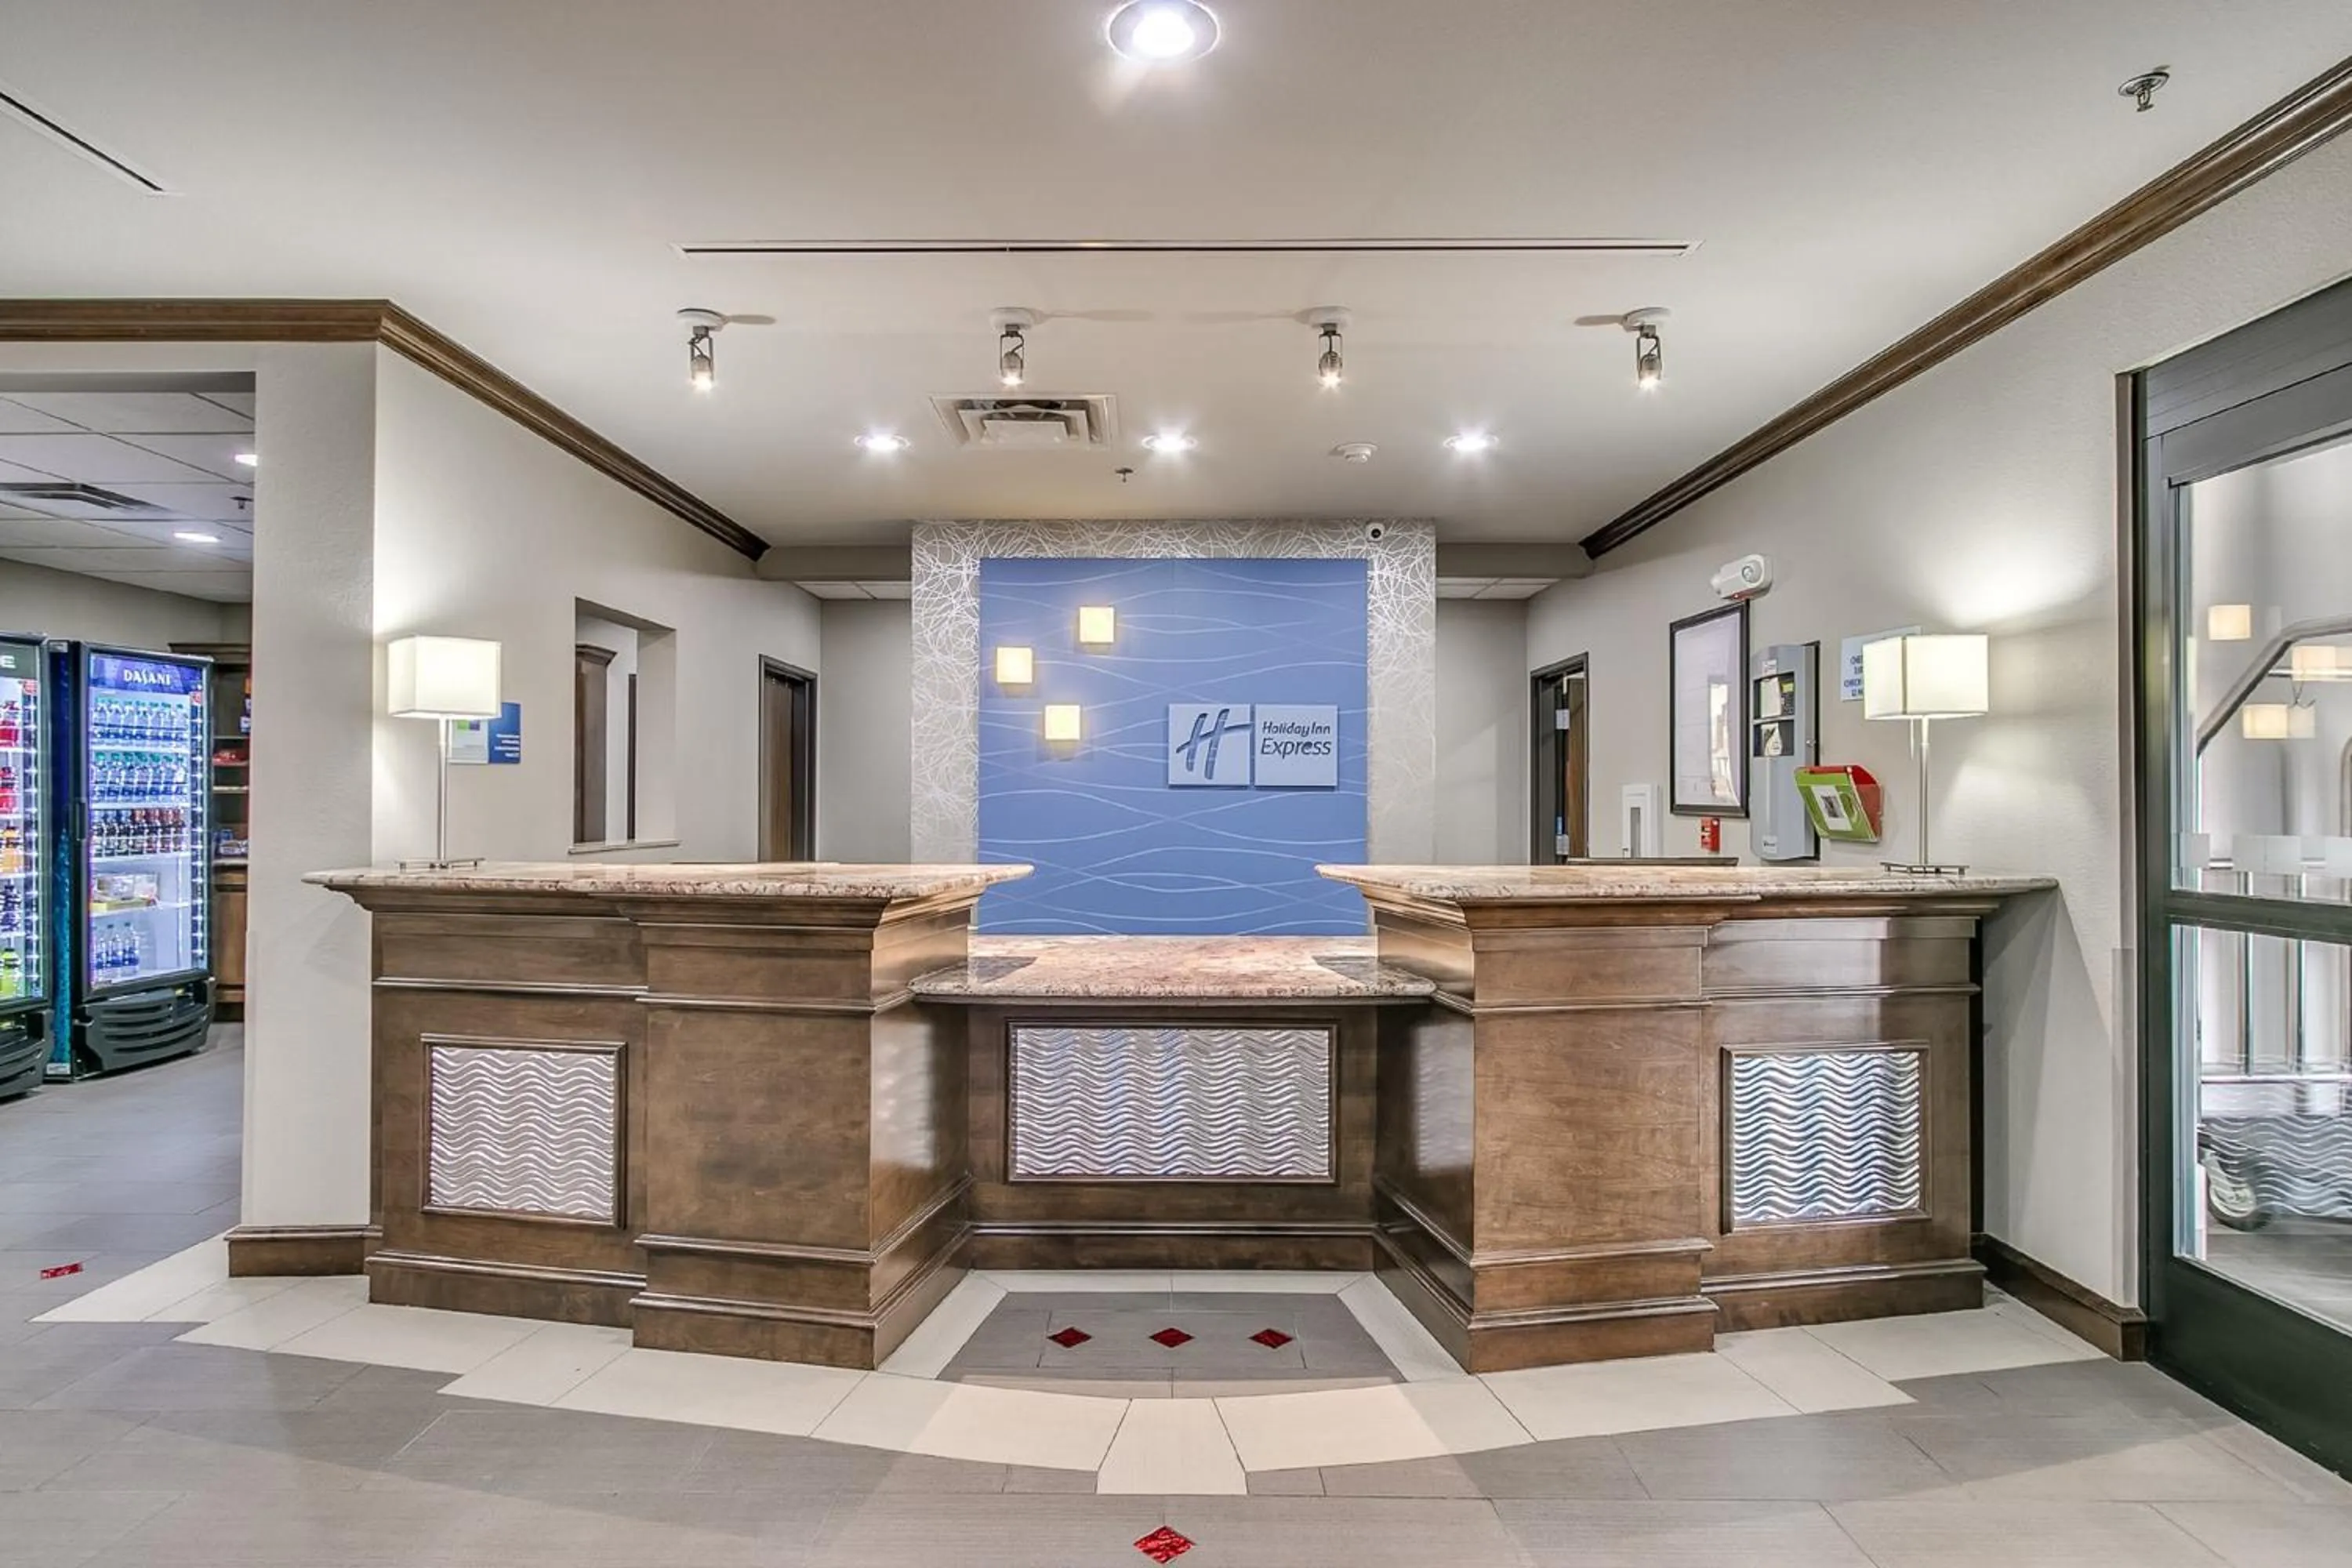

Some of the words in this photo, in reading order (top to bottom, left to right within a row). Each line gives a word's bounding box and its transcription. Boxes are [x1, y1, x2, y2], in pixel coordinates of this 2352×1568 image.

[124, 669, 171, 686] DASANI
[1261, 721, 1310, 738] Holiday
[1310, 721, 1330, 735] Inn
[1260, 738, 1332, 760] Express
